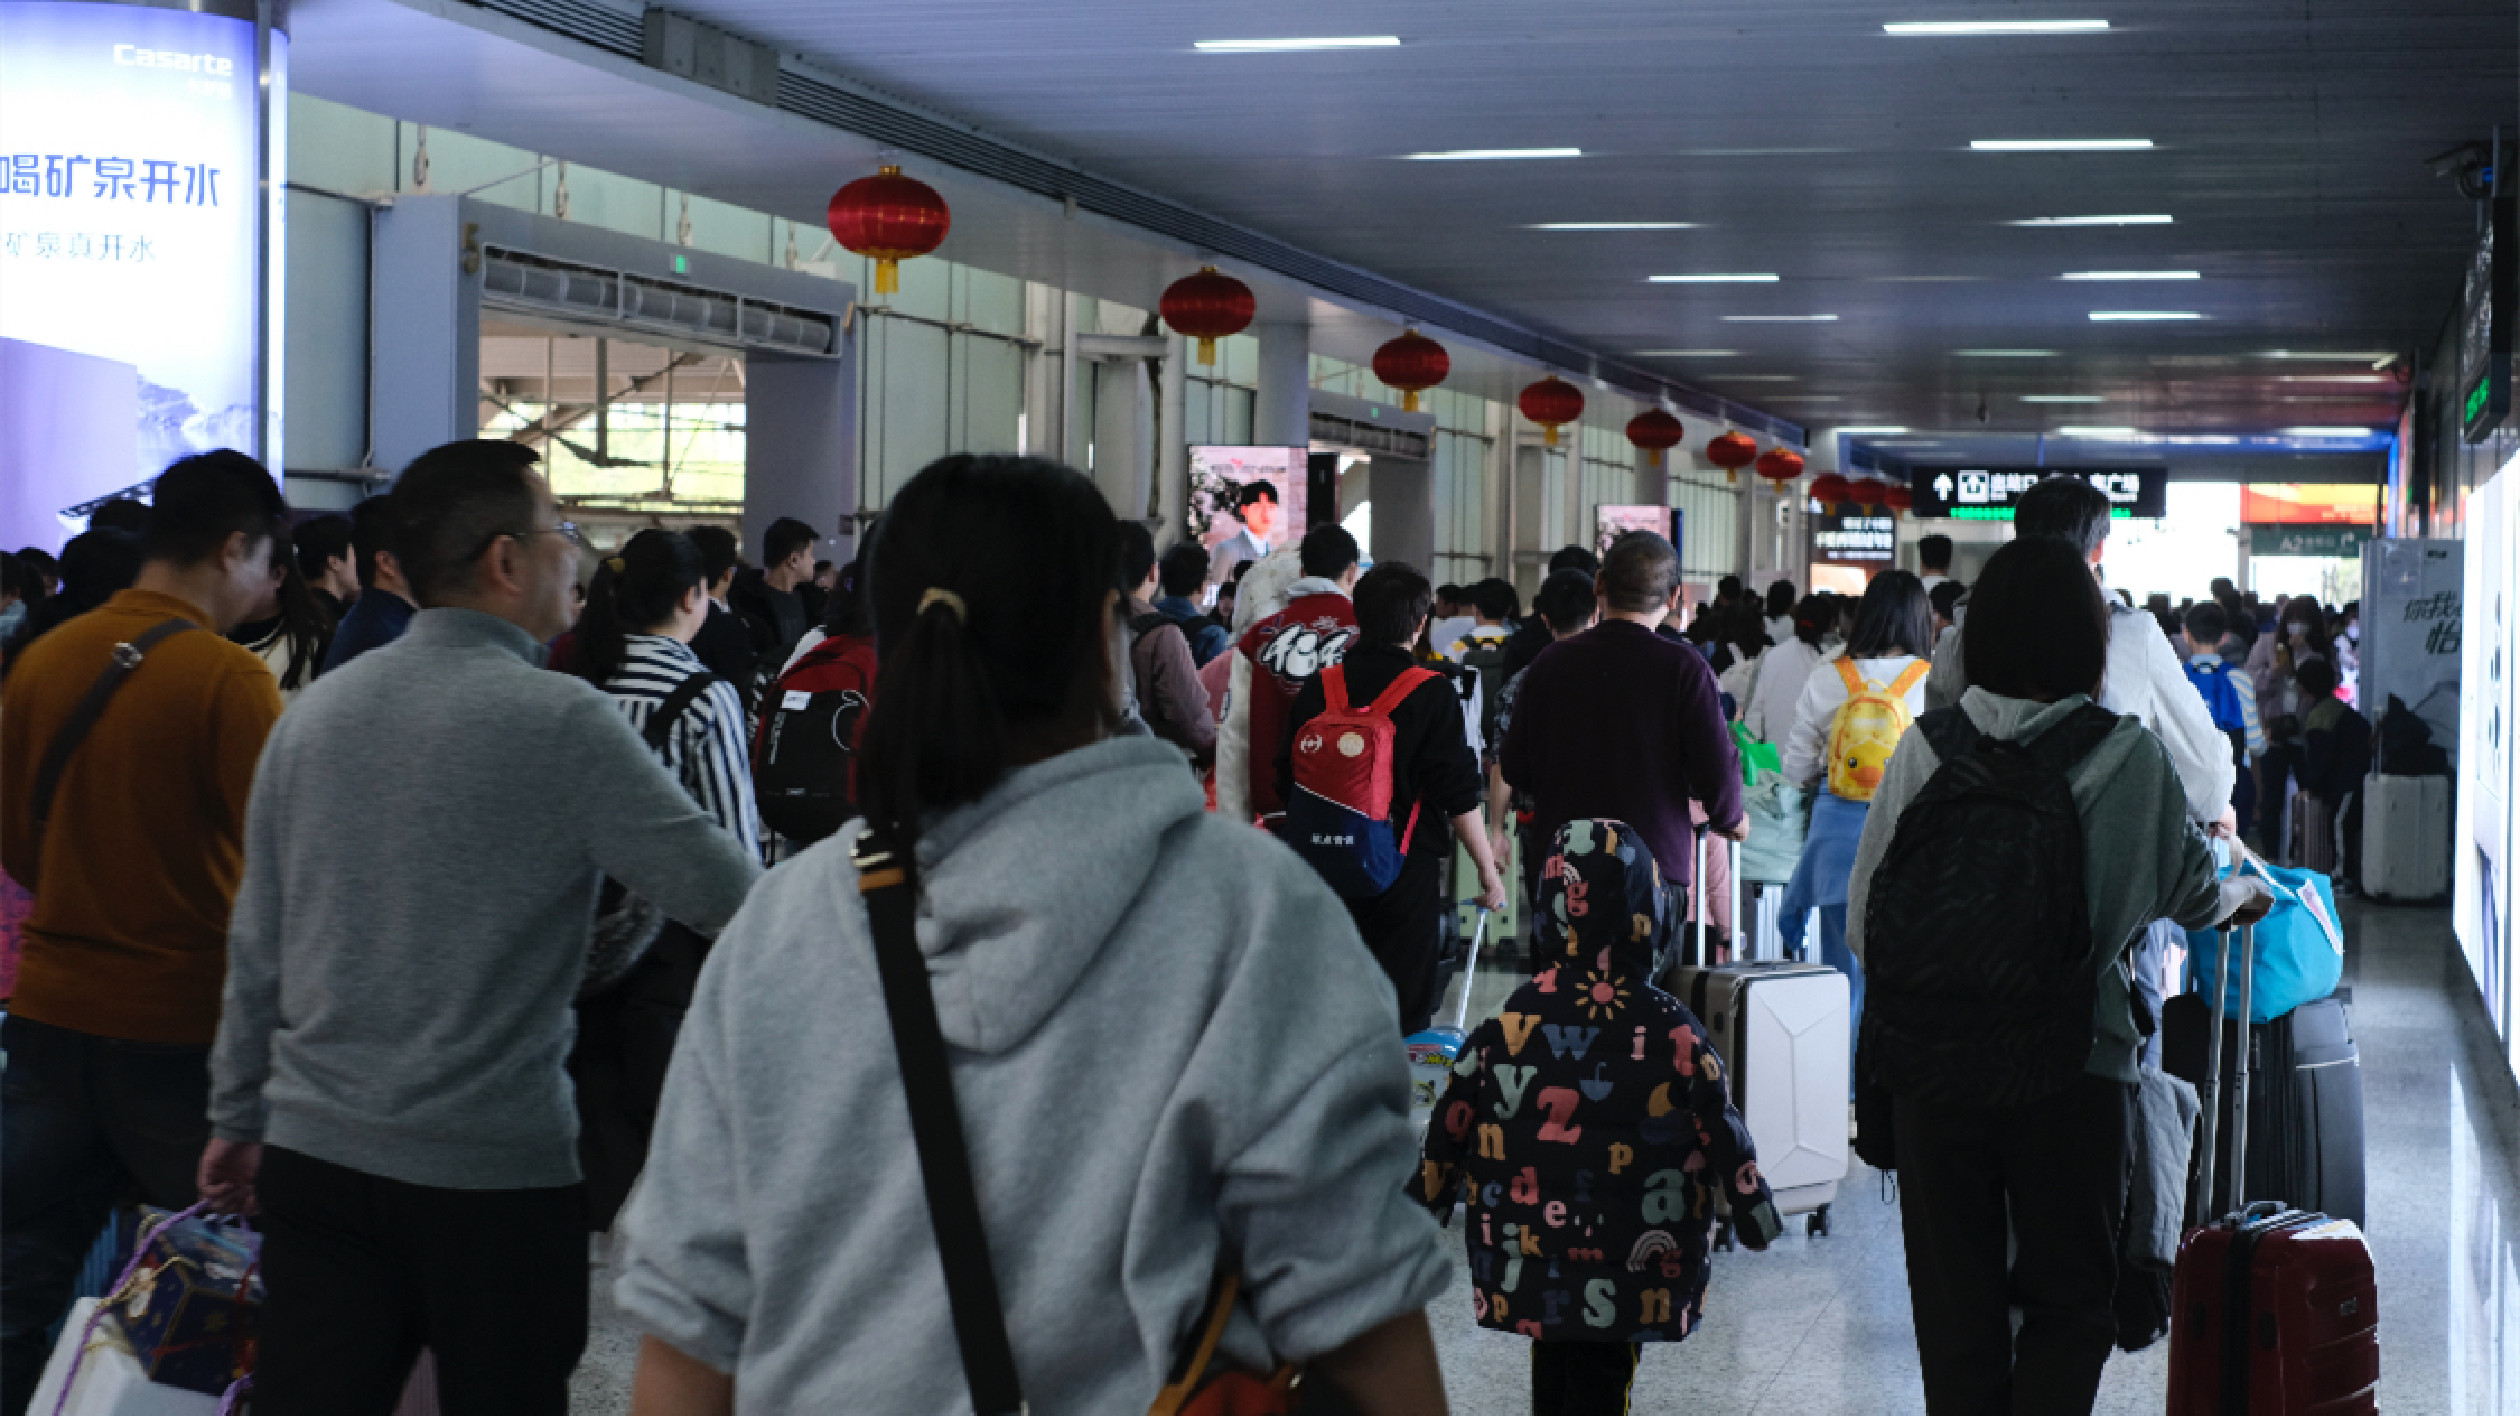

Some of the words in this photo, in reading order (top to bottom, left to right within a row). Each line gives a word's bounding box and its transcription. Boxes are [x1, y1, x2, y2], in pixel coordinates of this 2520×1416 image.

[113, 44, 233, 76] Casarte
[0, 154, 221, 207] 喝矿泉开水
[1631, 1026, 1647, 1060] i
[1494, 1064, 1538, 1119] y
[1478, 1122, 1506, 1160] n
[1608, 1142, 1633, 1174] p
[1510, 1166, 1539, 1205] d
[1642, 1169, 1685, 1225] a
[1543, 1201, 1567, 1228] e
[1641, 1287, 1671, 1325] n
